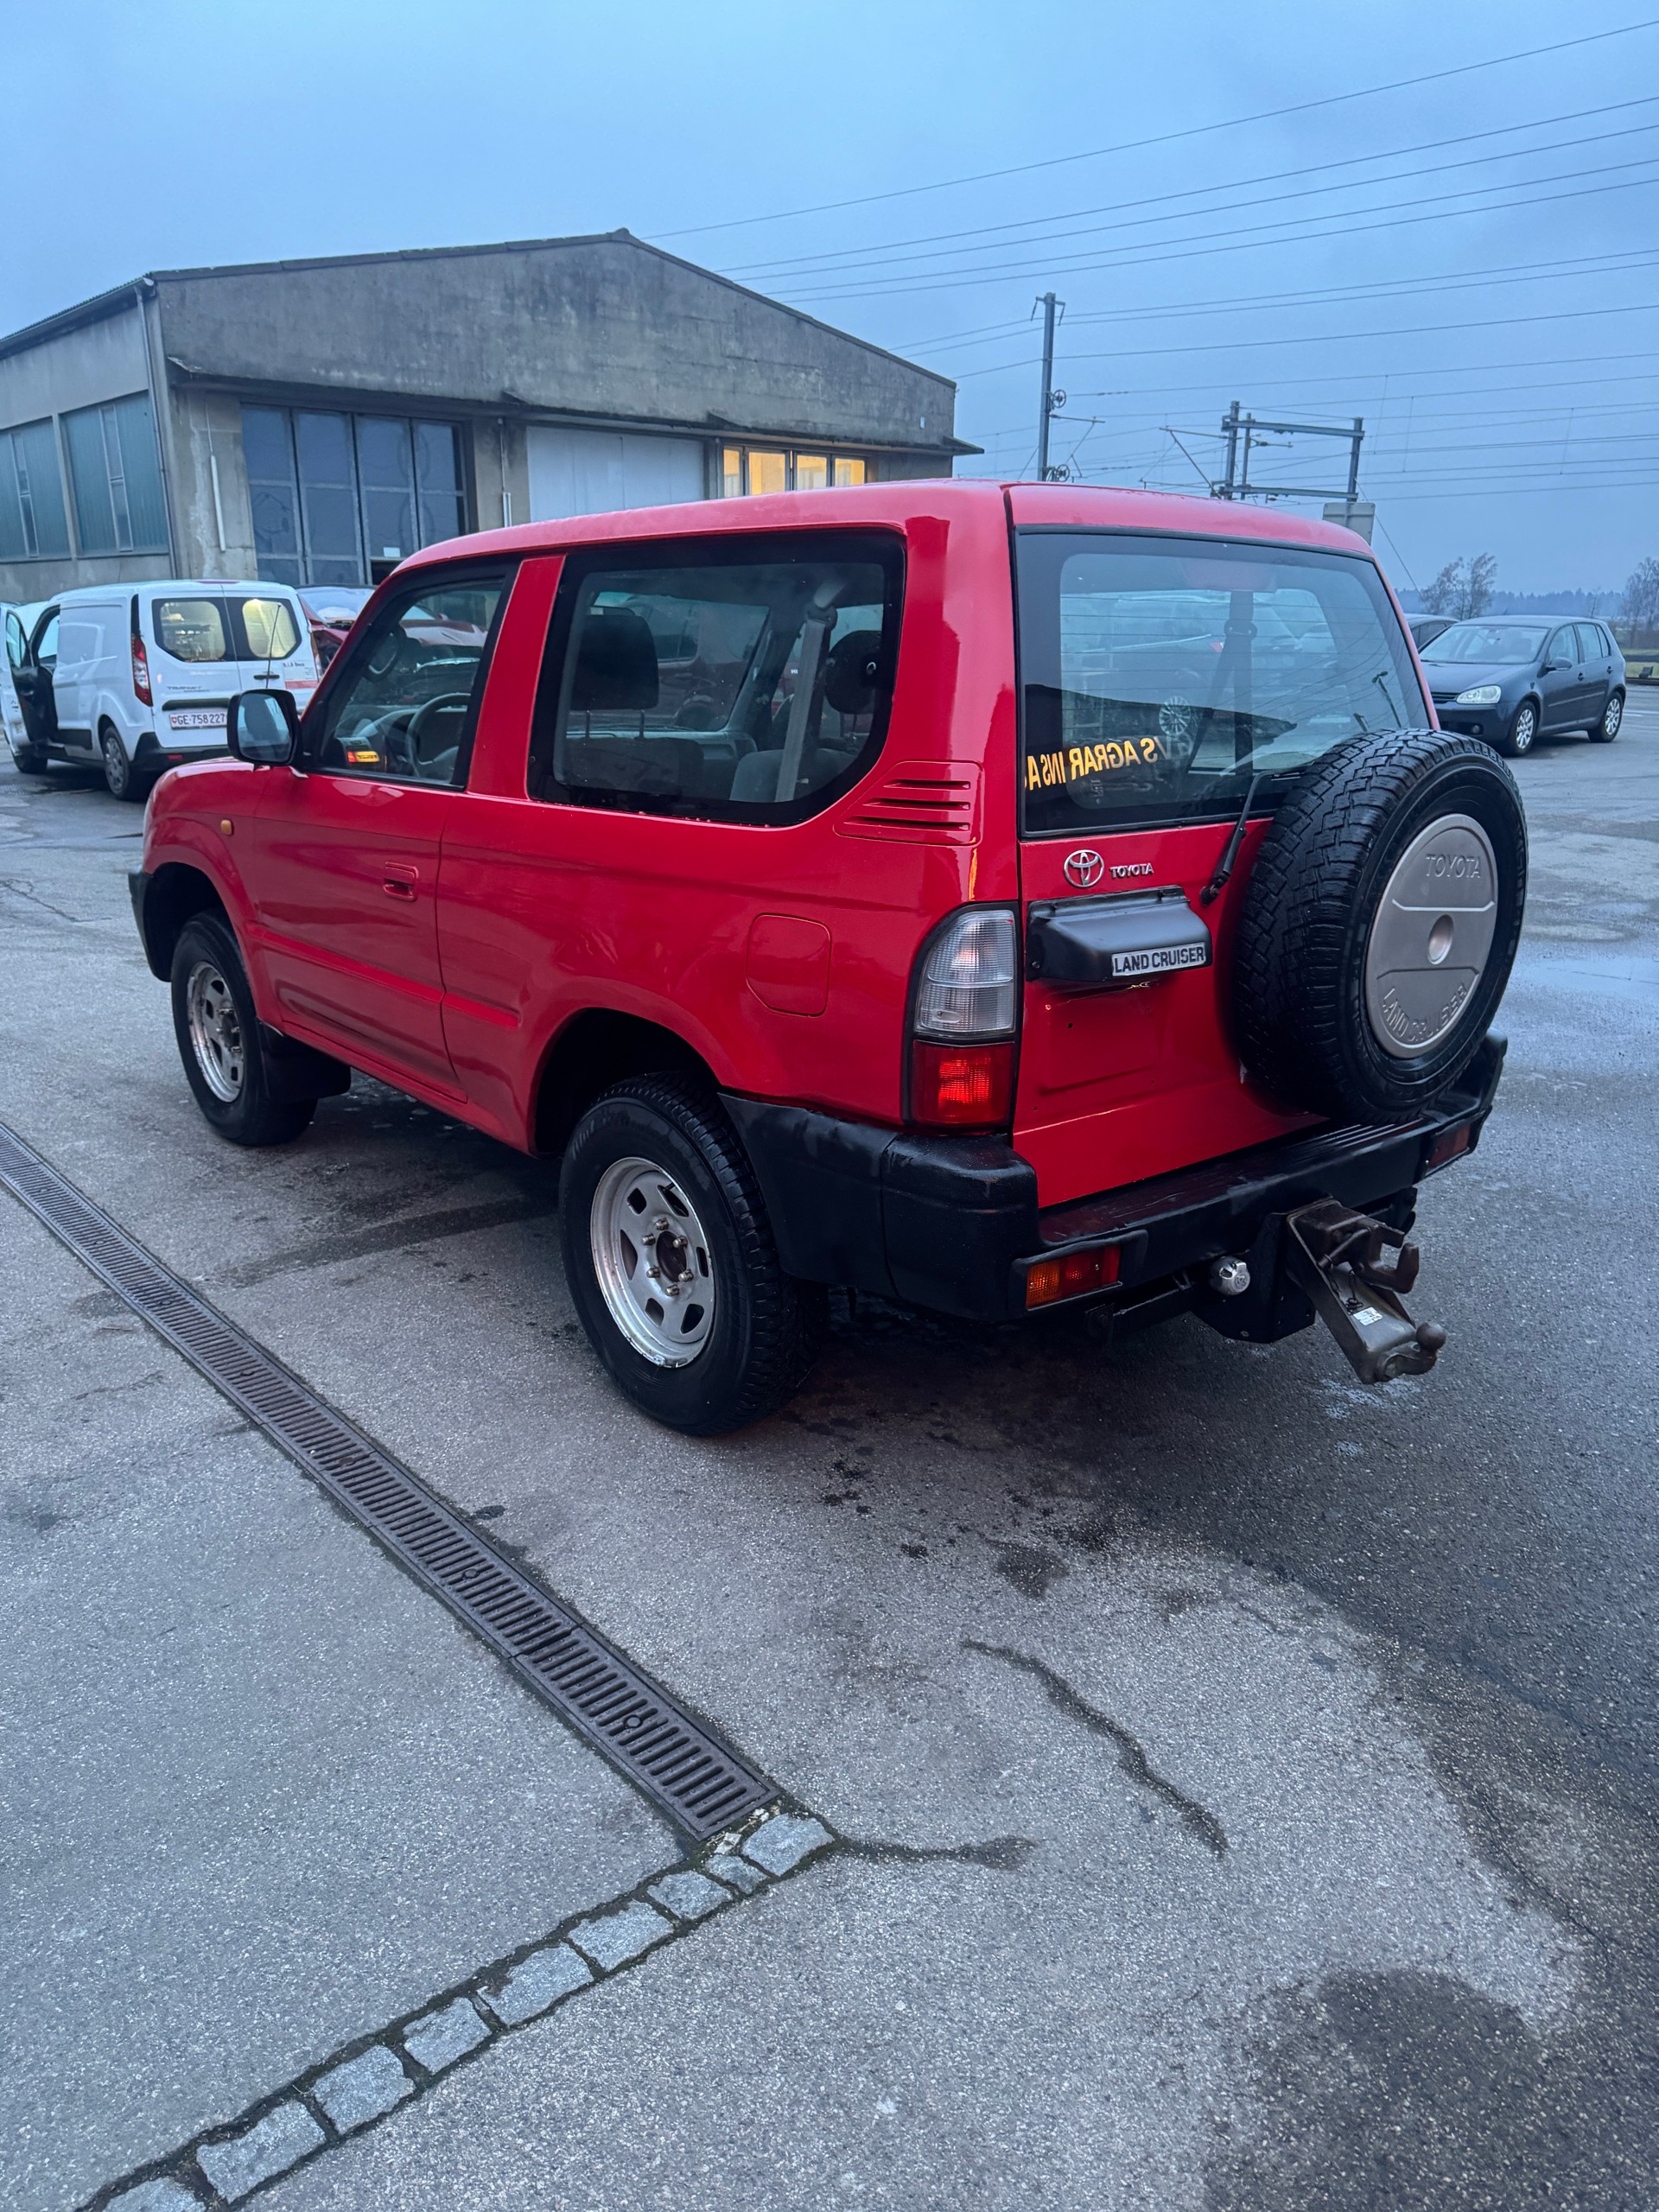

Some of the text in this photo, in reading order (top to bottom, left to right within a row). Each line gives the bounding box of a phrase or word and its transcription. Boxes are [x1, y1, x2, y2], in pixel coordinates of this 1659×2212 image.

[1110, 862, 1154, 879] TOYOTA
[1426, 854, 1481, 879] TOYOTA
[1115, 946, 1205, 973] LAND CRUISER
[1382, 986, 1409, 1038] LAND
